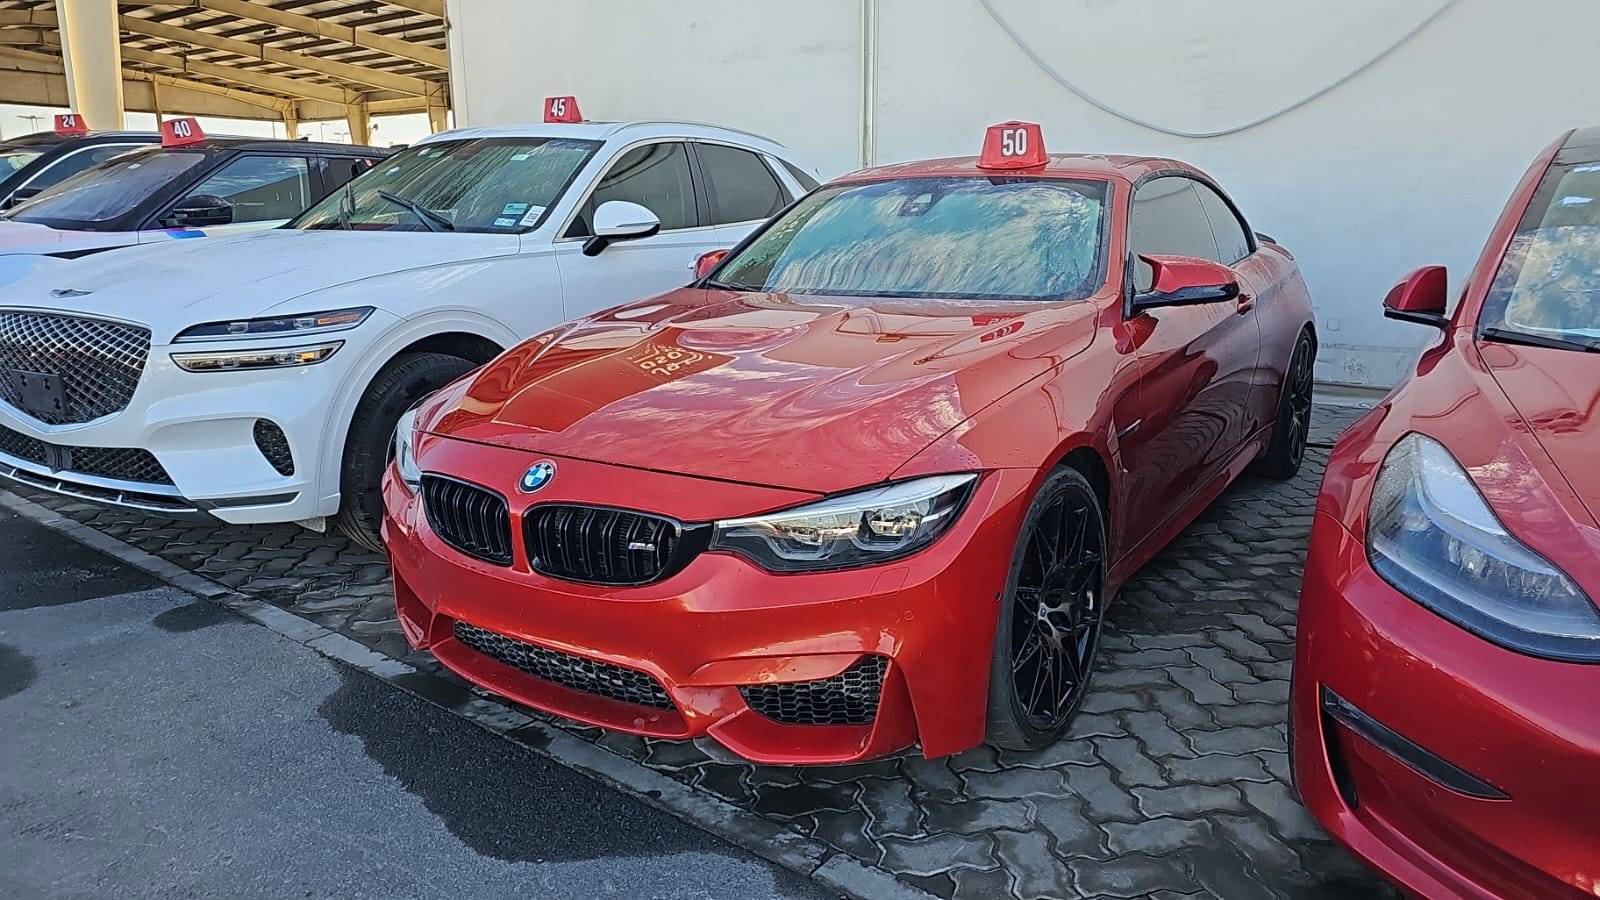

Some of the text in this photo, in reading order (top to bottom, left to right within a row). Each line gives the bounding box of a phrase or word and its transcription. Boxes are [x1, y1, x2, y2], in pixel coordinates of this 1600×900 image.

[551, 98, 566, 117] 45
[62, 115, 76, 128] 24
[173, 120, 192, 138] 40
[1002, 128, 1027, 156] 50
